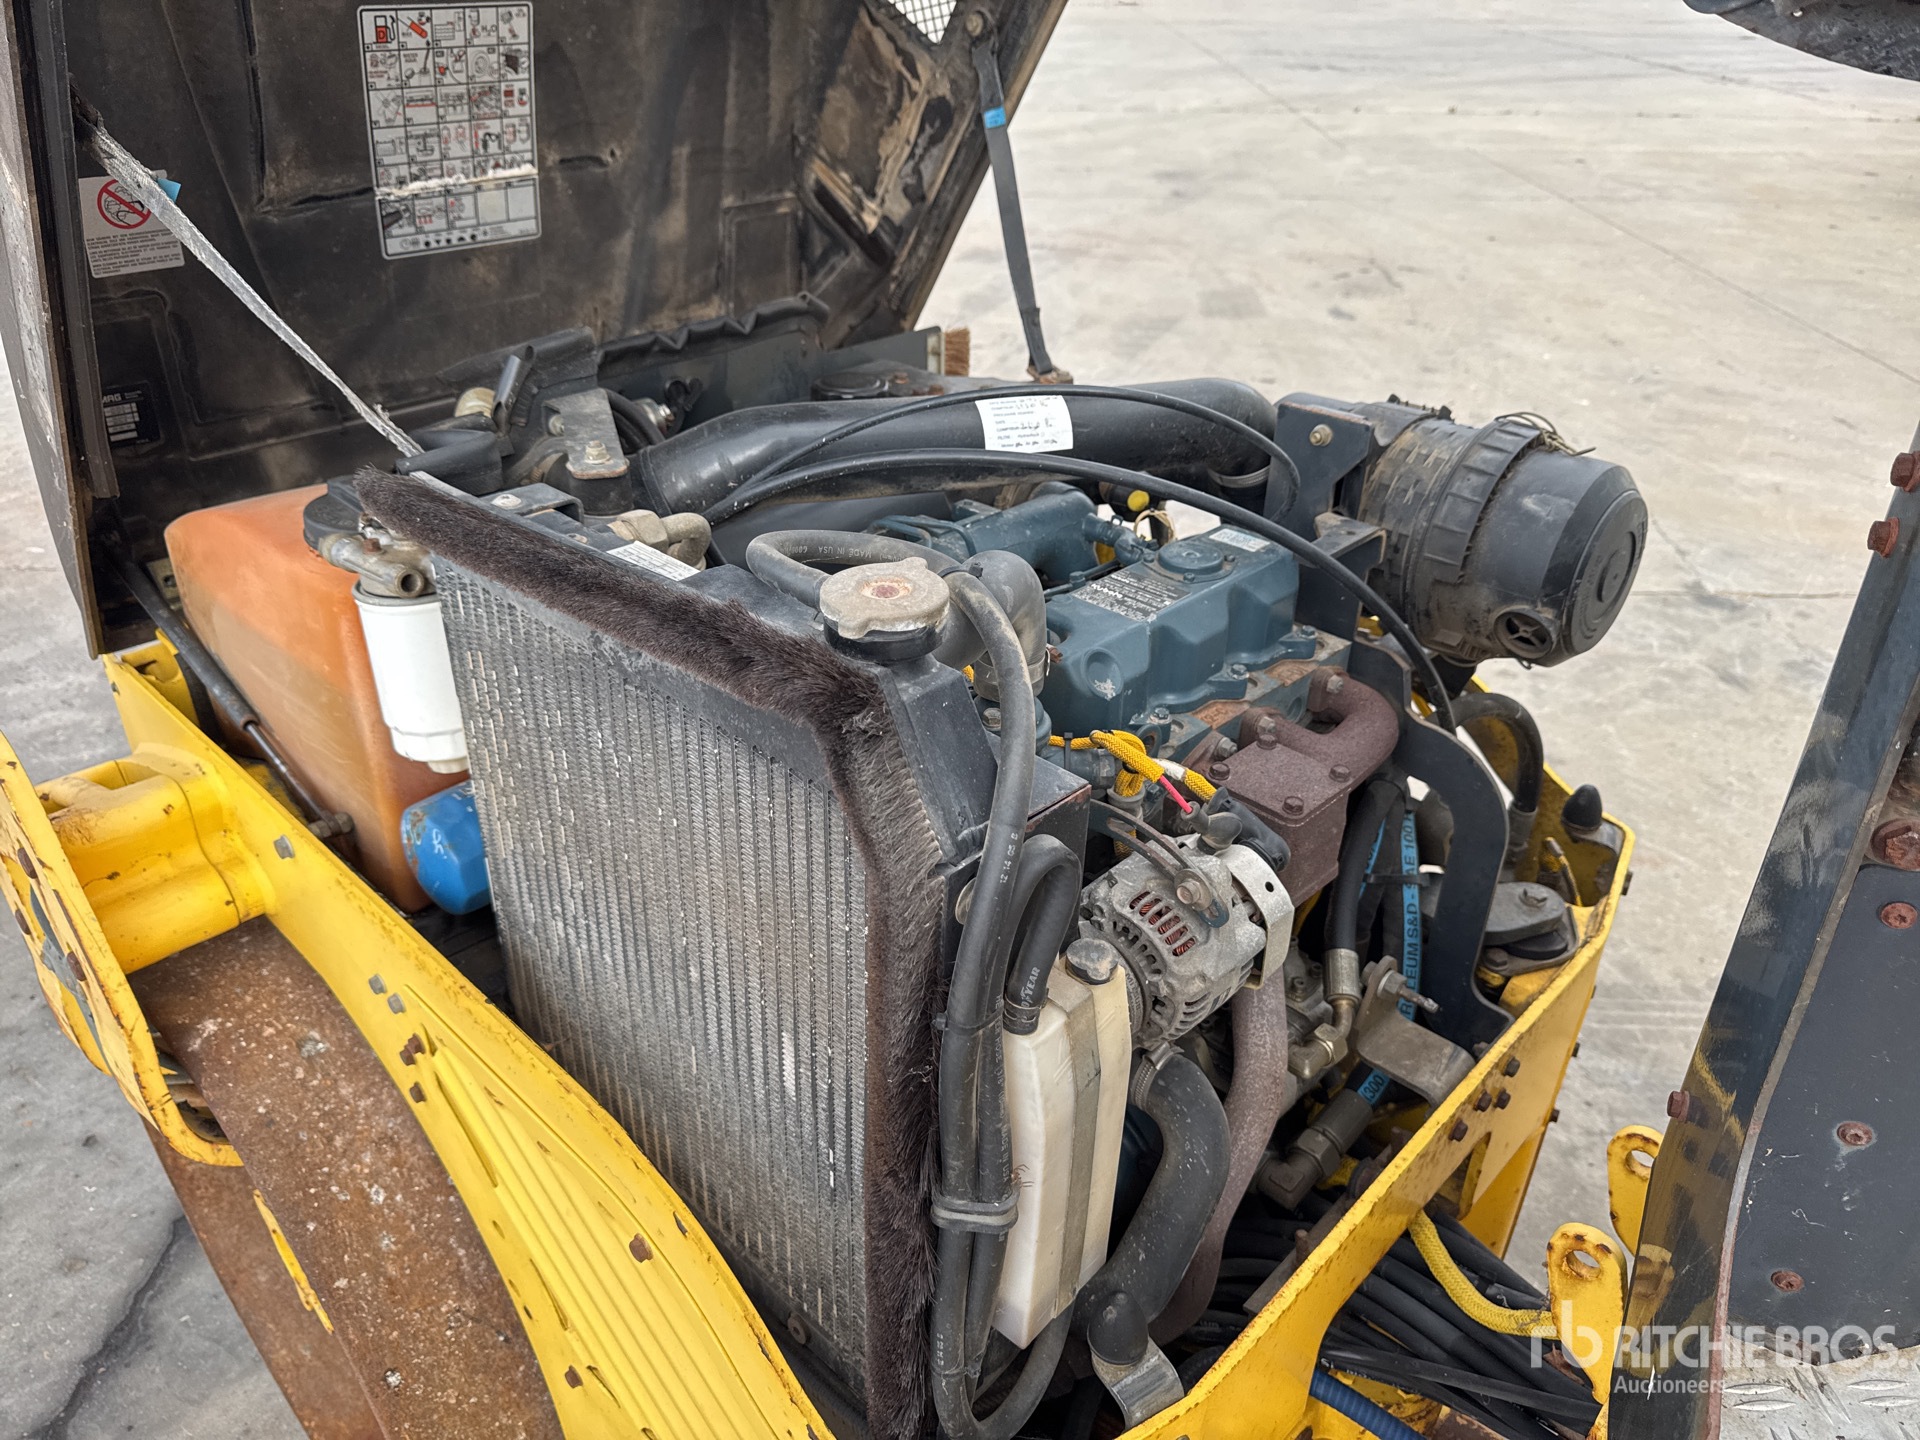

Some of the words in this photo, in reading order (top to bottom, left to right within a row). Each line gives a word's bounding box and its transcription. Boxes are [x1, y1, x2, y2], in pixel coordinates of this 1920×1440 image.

[818, 546, 833, 554] USA
[837, 547, 845, 555] IN
[849, 548, 872, 558] MADE
[1402, 825, 1415, 849] 100
[1406, 904, 1419, 938] S&D
